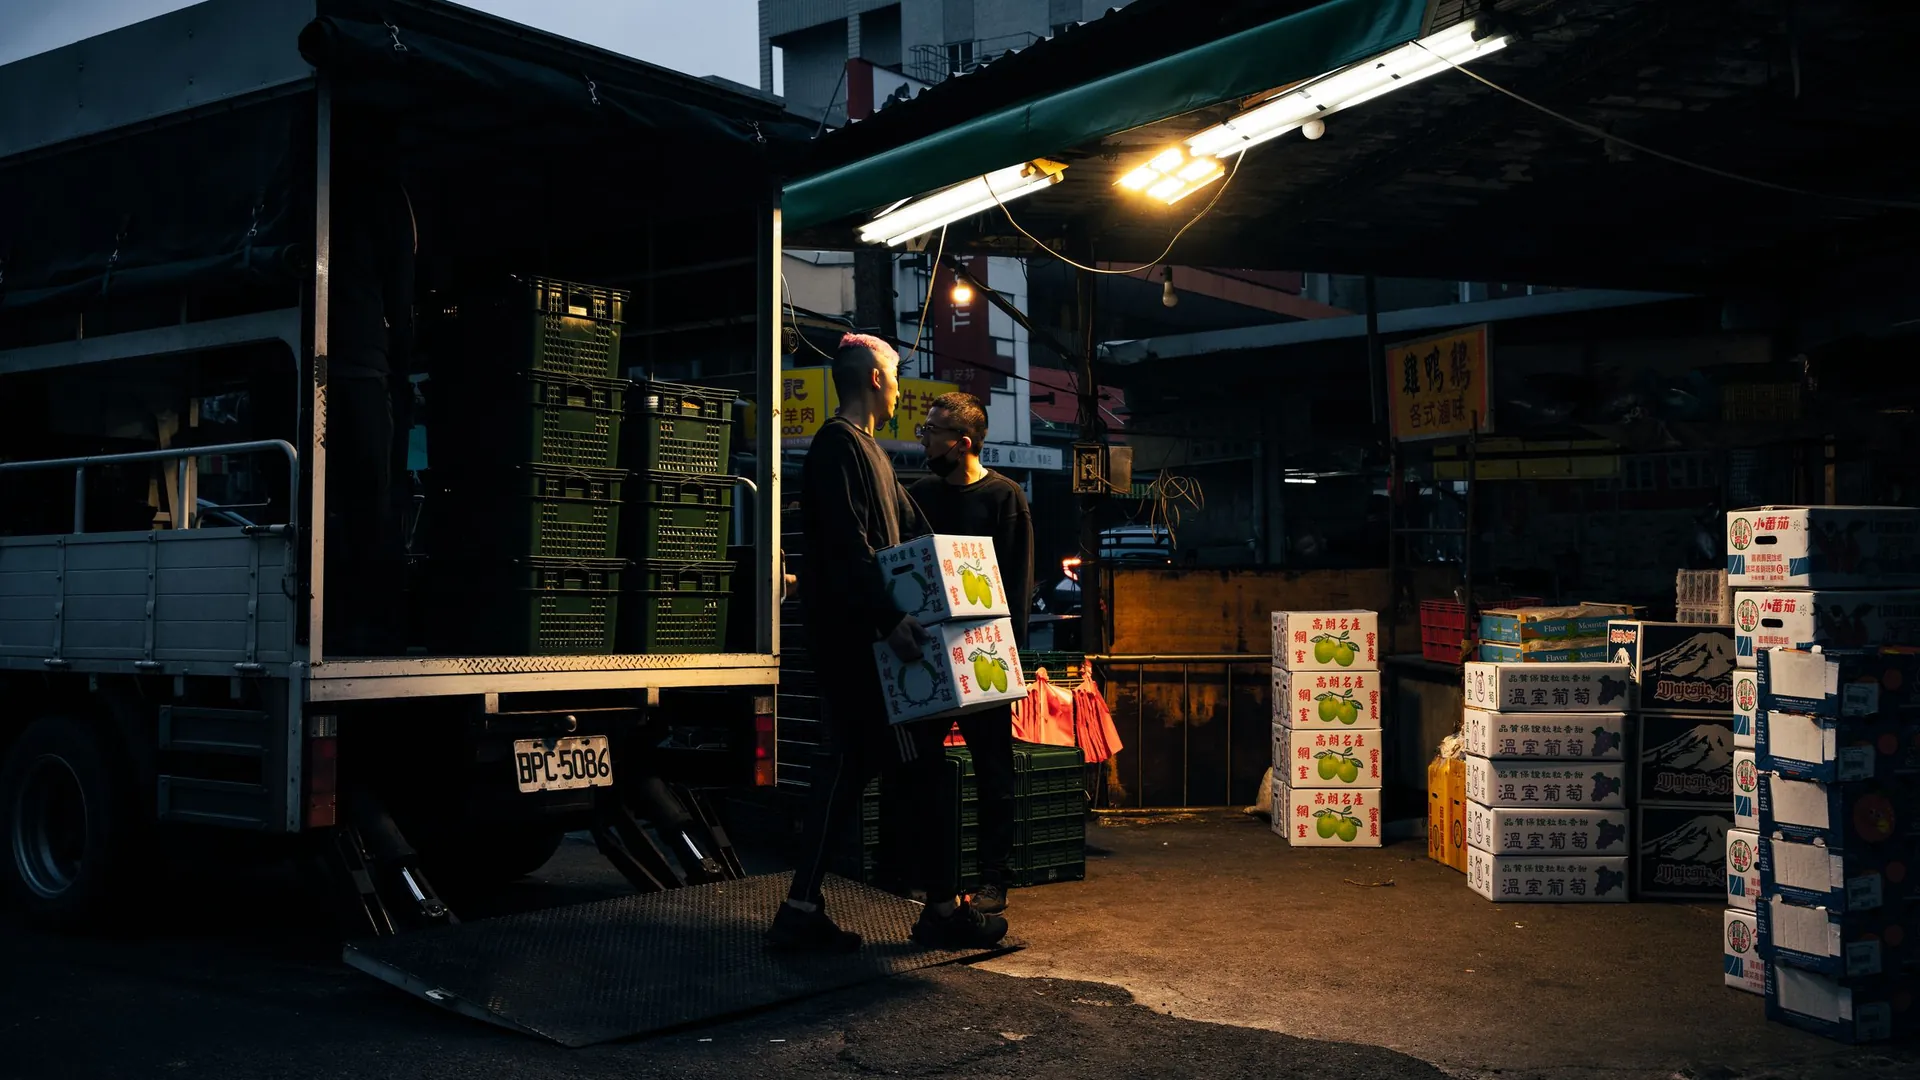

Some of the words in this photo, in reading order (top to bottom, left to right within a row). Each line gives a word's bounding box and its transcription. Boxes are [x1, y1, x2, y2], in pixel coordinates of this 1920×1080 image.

[783, 407, 815, 424] 羊肉
[1409, 396, 1466, 429] 各式滷味
[1312, 618, 1361, 630] 高朗名產
[1544, 624, 1566, 633] Flavor
[1578, 621, 1608, 630] Mounta
[964, 625, 1003, 645] 高朗名產
[1294, 631, 1307, 663] 網室
[1366, 632, 1376, 661] 蜜棗
[1545, 654, 1568, 662] Flavor
[1580, 651, 1608, 659] Mounta
[1316, 676, 1364, 688] 高朗名產
[1653, 680, 1712, 702] Majestic
[1298, 689, 1311, 722] 網室
[1369, 691, 1379, 720] 蜜棗
[1508, 688, 1590, 706] 溫室葡萄
[1315, 734, 1364, 747] 高朗名產
[1499, 739, 1584, 757] 溫室葡萄
[1297, 747, 1310, 779] 網室
[1369, 748, 1379, 778] 蜜棗
[1498, 784, 1583, 801] 溫室葡萄
[1653, 772, 1712, 794] Majestic
[1314, 793, 1364, 806] 高朗名產
[1296, 805, 1309, 838] 網室
[1369, 807, 1379, 837] 蜜棗
[1503, 832, 1588, 849] 溫室葡萄
[1652, 864, 1713, 886] Majestic
[1502, 878, 1586, 896] 溫室葡萄
